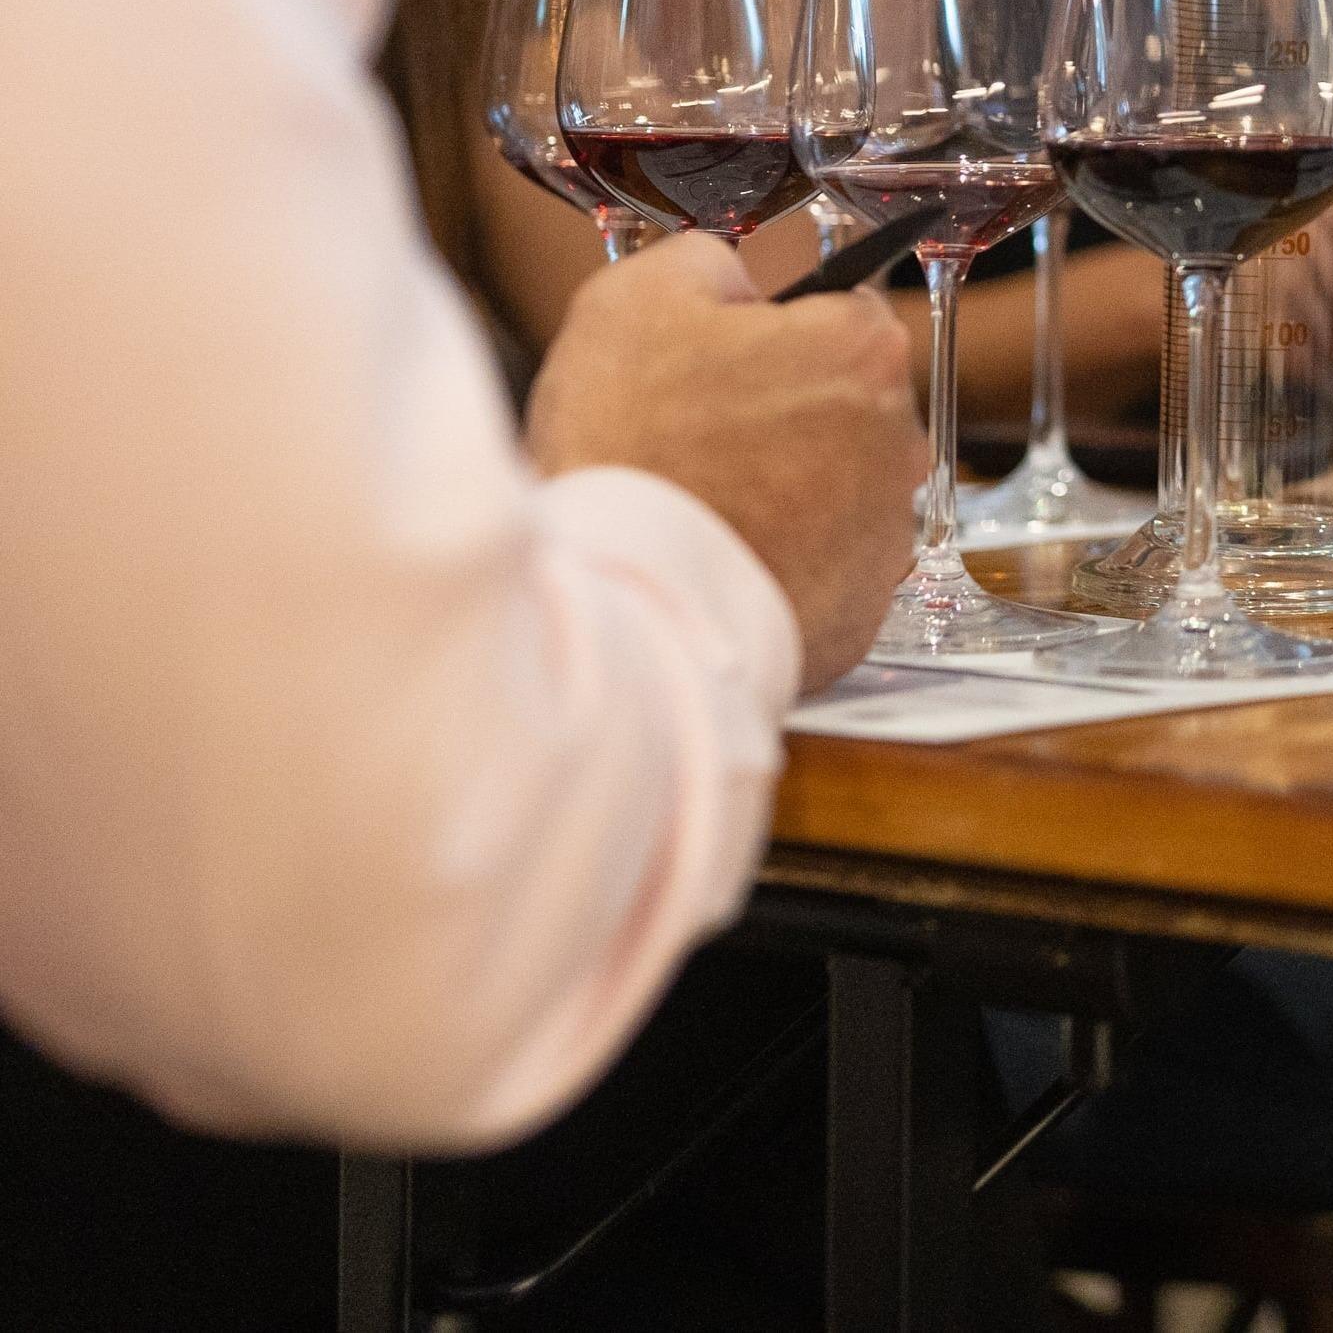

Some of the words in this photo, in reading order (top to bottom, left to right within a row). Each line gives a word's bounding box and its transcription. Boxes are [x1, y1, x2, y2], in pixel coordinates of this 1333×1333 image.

[1269, 40, 1310, 67] 250
[1262, 321, 1309, 347] 100
[1266, 414, 1298, 438] 50
